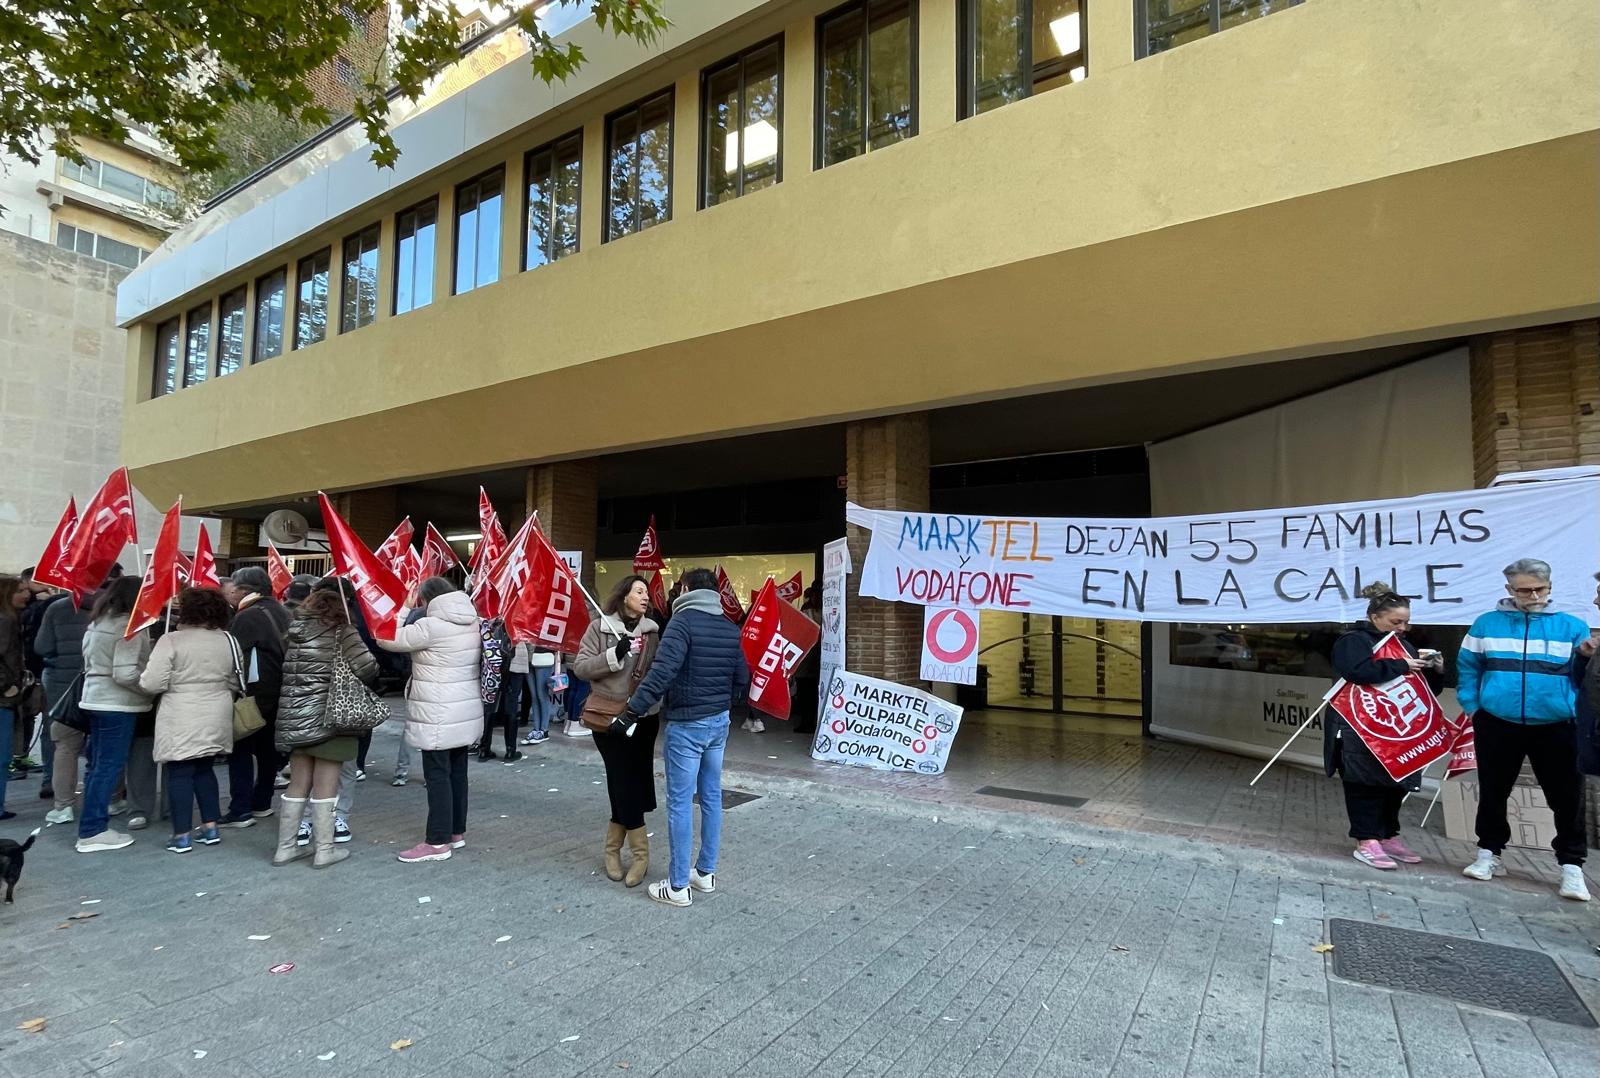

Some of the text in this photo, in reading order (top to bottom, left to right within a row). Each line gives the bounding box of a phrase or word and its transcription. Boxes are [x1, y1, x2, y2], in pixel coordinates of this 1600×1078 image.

[898, 508, 1491, 565] MARKTEL DEJAN 55 FAMILIAS
[896, 563, 1465, 612] VODAFONE EN LA CALLE
[854, 683, 930, 716] MARKTEL
[1263, 701, 1323, 731] MAGNA
[844, 701, 926, 734] CULPABLE
[845, 717, 912, 747] Vodafone
[837, 740, 916, 769] CÓMPLICE
